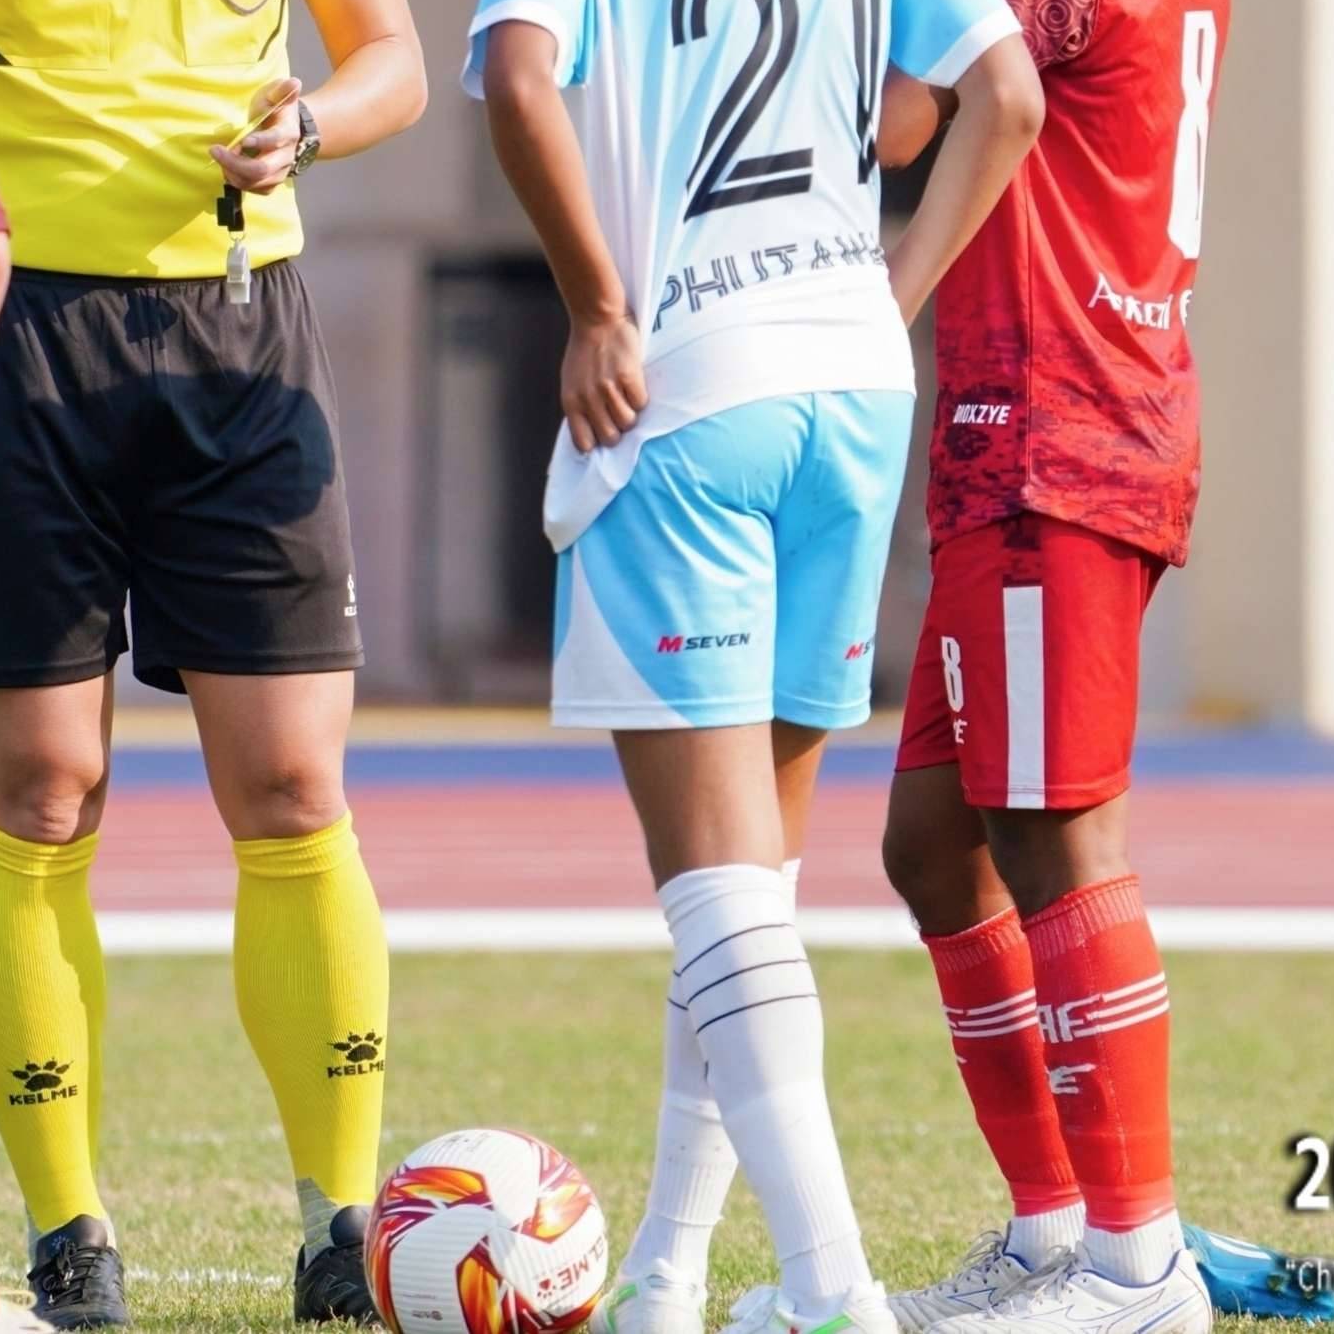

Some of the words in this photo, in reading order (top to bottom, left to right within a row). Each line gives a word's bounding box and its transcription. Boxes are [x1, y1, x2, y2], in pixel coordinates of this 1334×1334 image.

[1167, 9, 1218, 260] 8
[940, 635, 964, 713] 8
[9, 1085, 78, 1106] KELME
